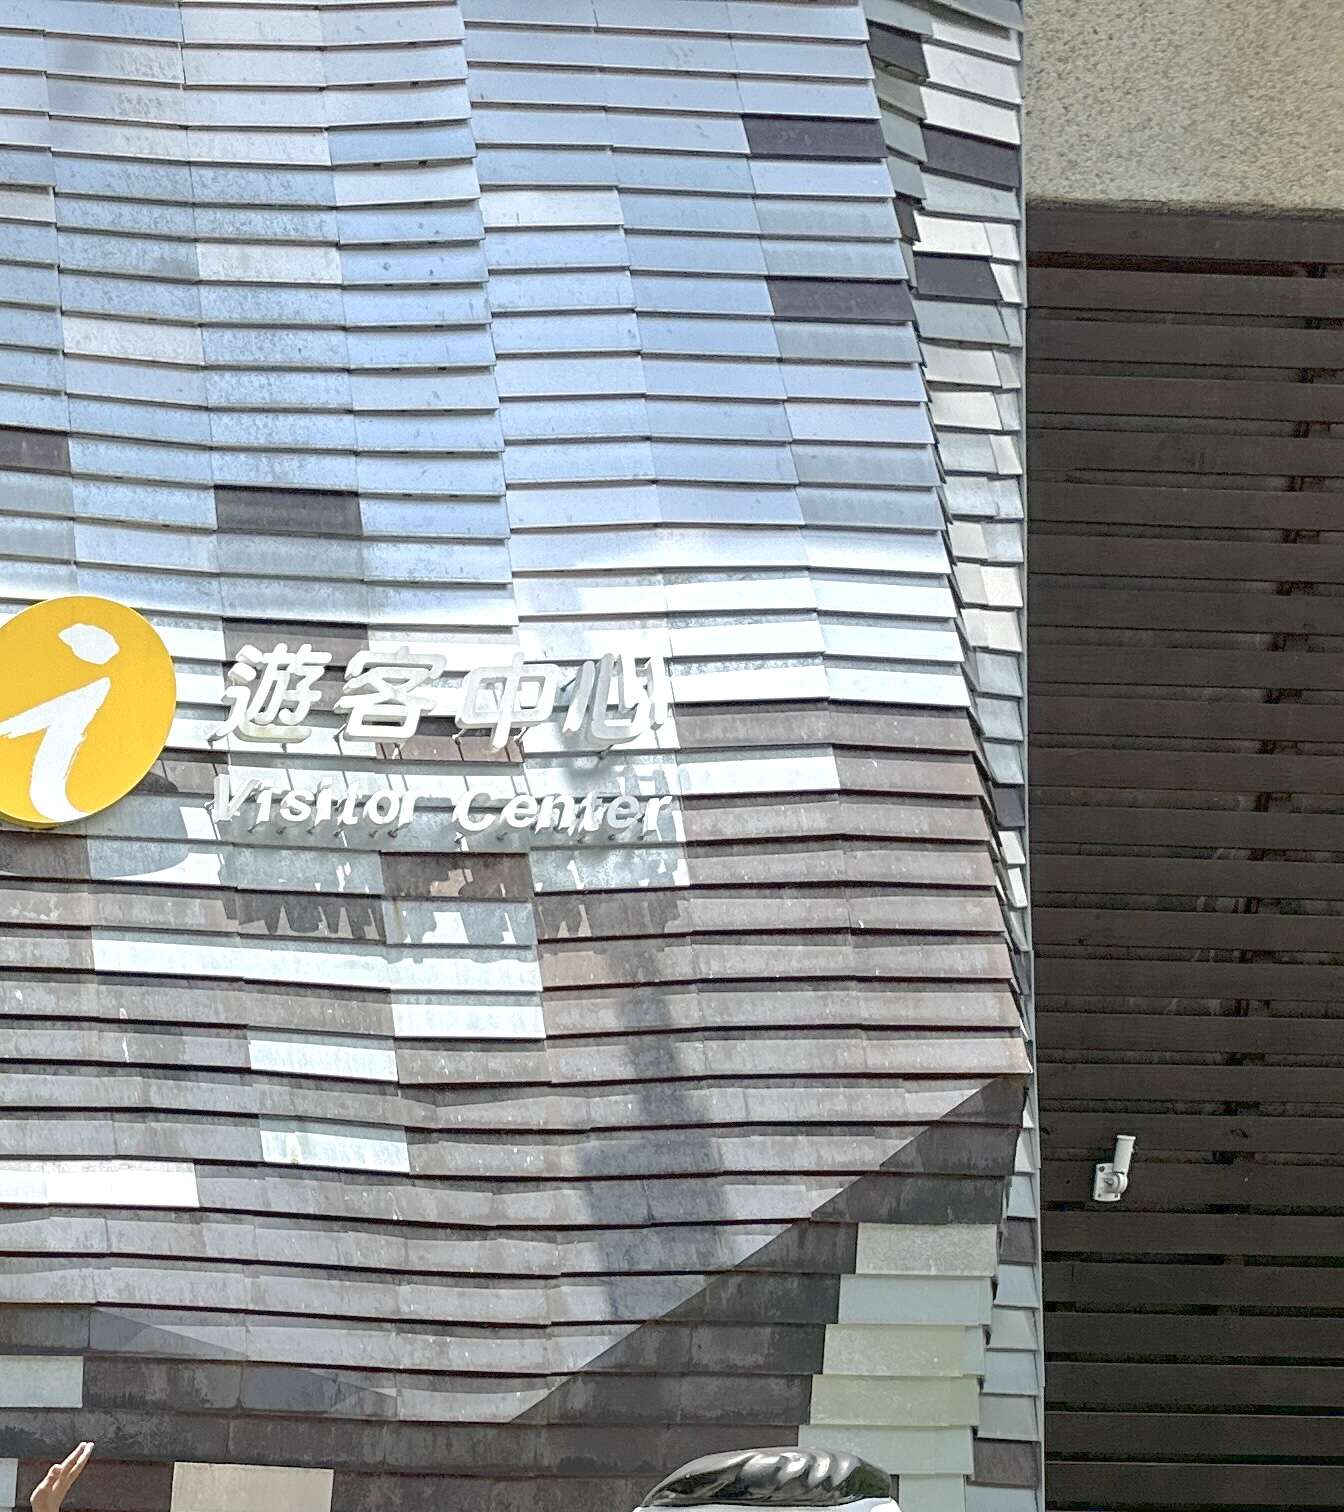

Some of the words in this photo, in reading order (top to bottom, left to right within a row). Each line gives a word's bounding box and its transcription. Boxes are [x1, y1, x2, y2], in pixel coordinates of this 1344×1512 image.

[210, 643, 669, 749] 遊客中心
[214, 774, 422, 824] Visitor
[454, 791, 672, 835] Center
